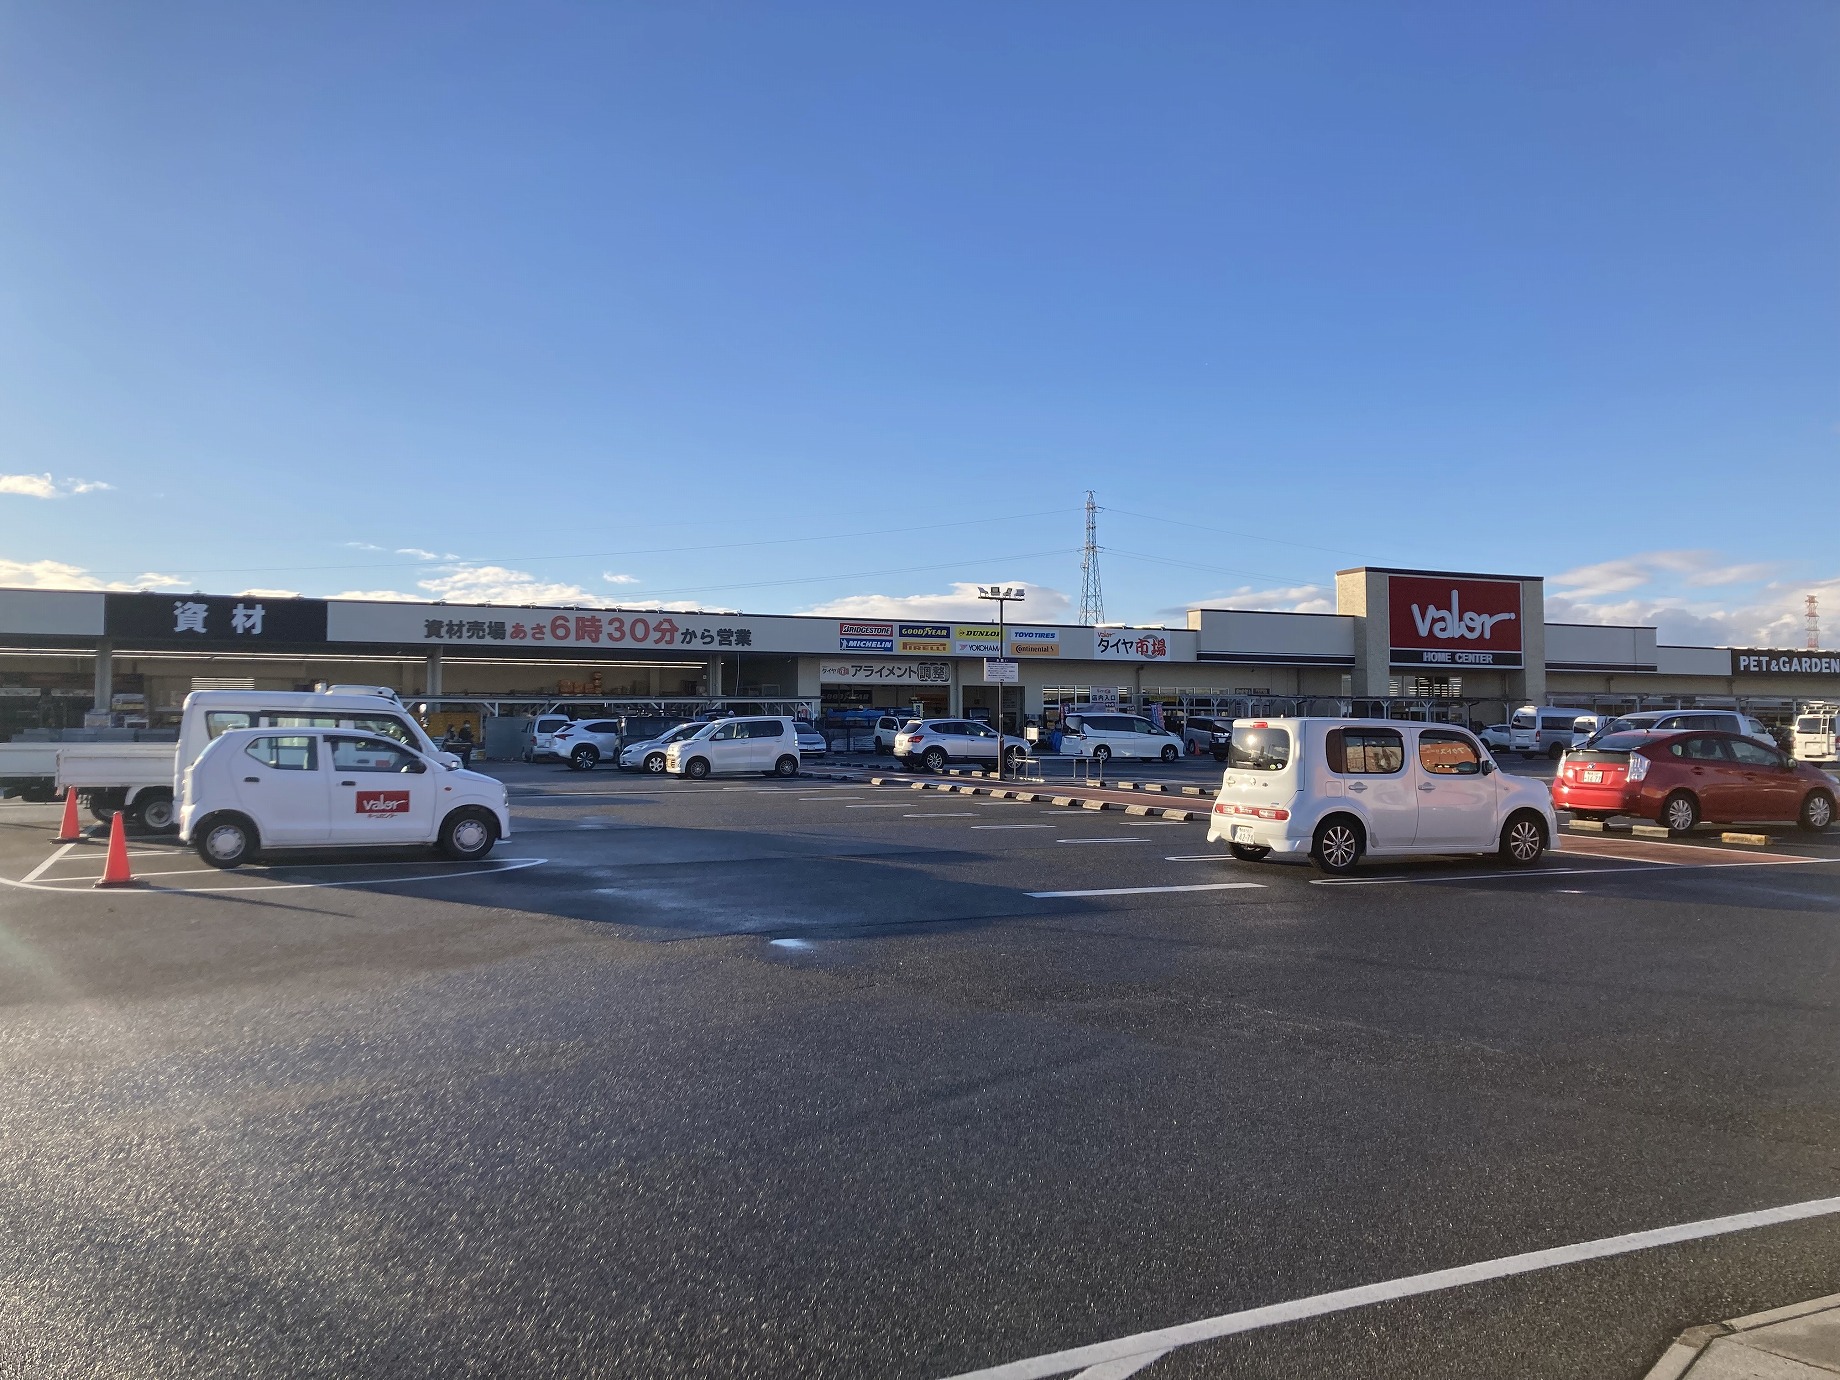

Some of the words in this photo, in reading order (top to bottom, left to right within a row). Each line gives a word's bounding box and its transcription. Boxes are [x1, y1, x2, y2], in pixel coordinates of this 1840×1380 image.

[1411, 589, 1516, 640] valor
[842, 624, 892, 636] BRIDGESTONE
[847, 639, 892, 649] MICHELIN
[902, 641, 947, 652] PIRELLI
[968, 644, 1000, 652] YOKOHAM
[1015, 643, 1049, 654] Continental
[1097, 637, 1167, 657] タイヤ市場
[1422, 651, 1452, 663] HOME
[1454, 653, 1494, 664] CENTER
